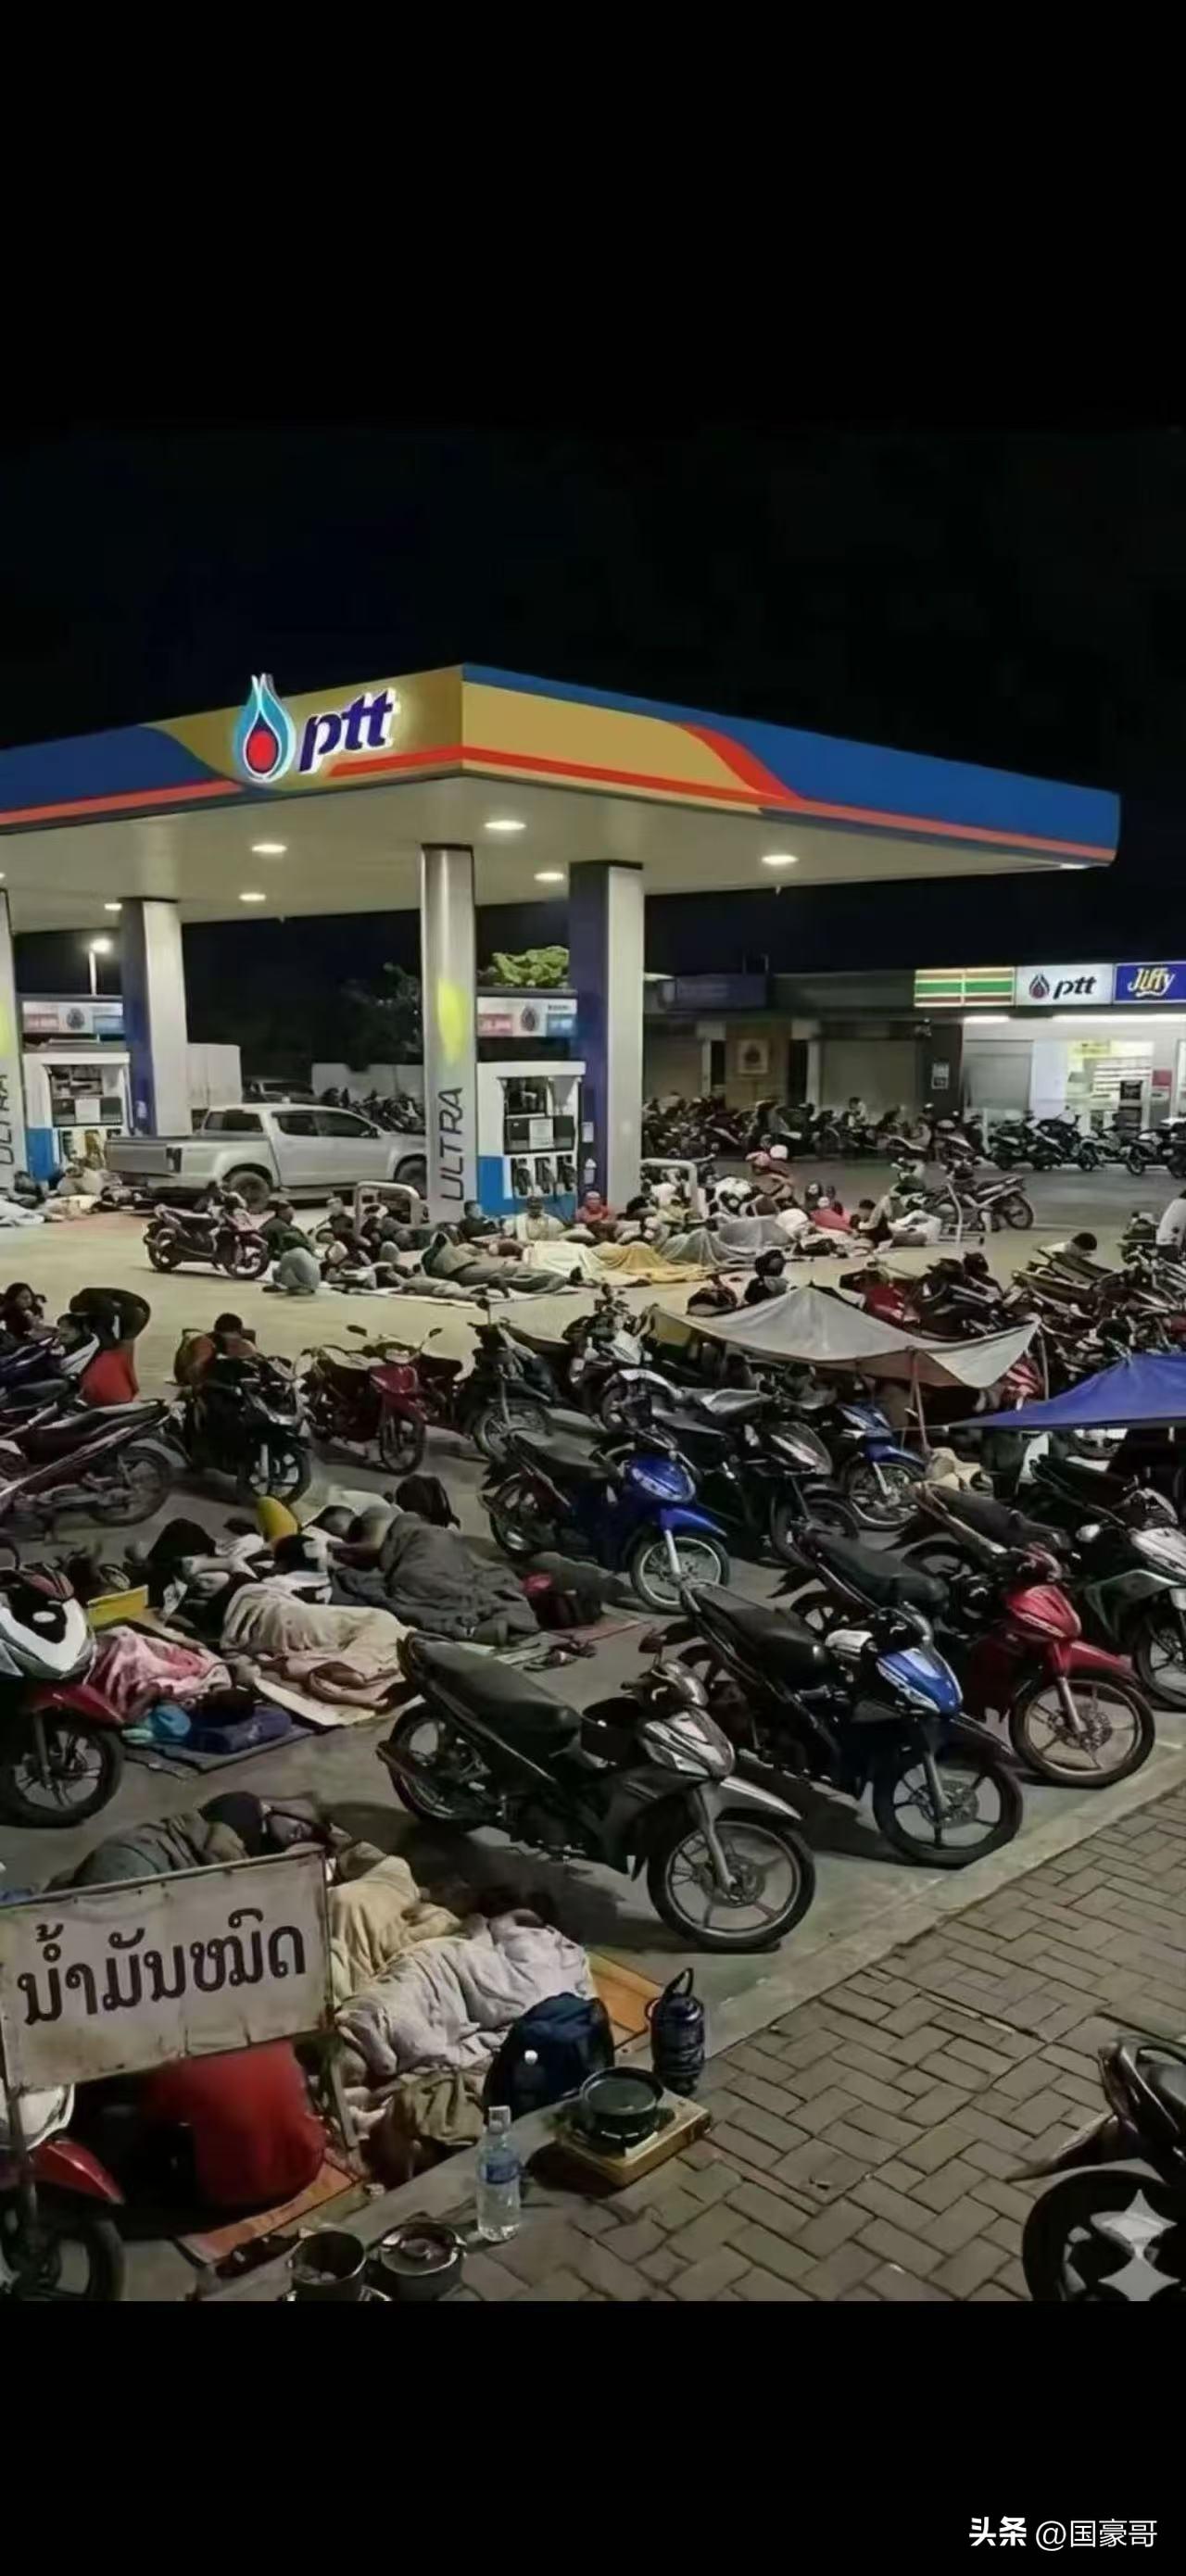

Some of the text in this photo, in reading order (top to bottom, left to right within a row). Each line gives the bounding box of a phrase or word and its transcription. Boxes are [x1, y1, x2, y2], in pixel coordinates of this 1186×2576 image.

[298, 688, 396, 773] ptt
[1054, 975, 1097, 999] ptt
[1127, 968, 1176, 998] Jiffy
[438, 1087, 463, 1201] ULTRA
